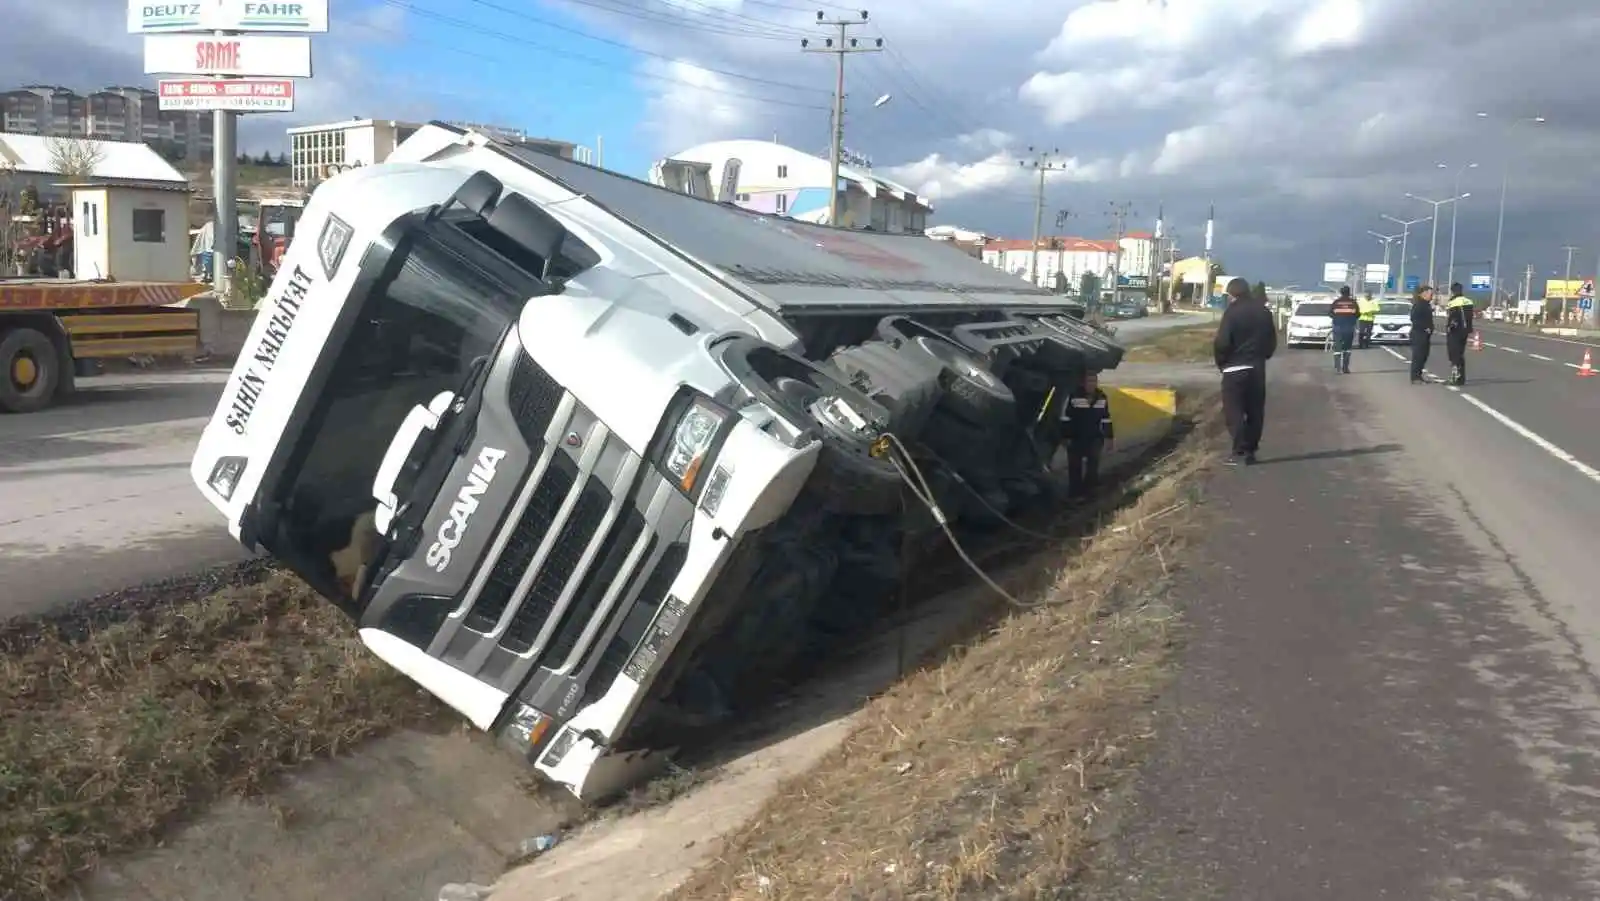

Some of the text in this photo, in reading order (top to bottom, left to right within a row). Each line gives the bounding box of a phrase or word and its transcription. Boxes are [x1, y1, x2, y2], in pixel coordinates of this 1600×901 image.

[142, 3, 304, 18] DEUTZ FAHR
[195, 41, 241, 70] SAME
[253, 263, 315, 372] NAKLİYAT
[425, 446, 507, 573] SCANIA
